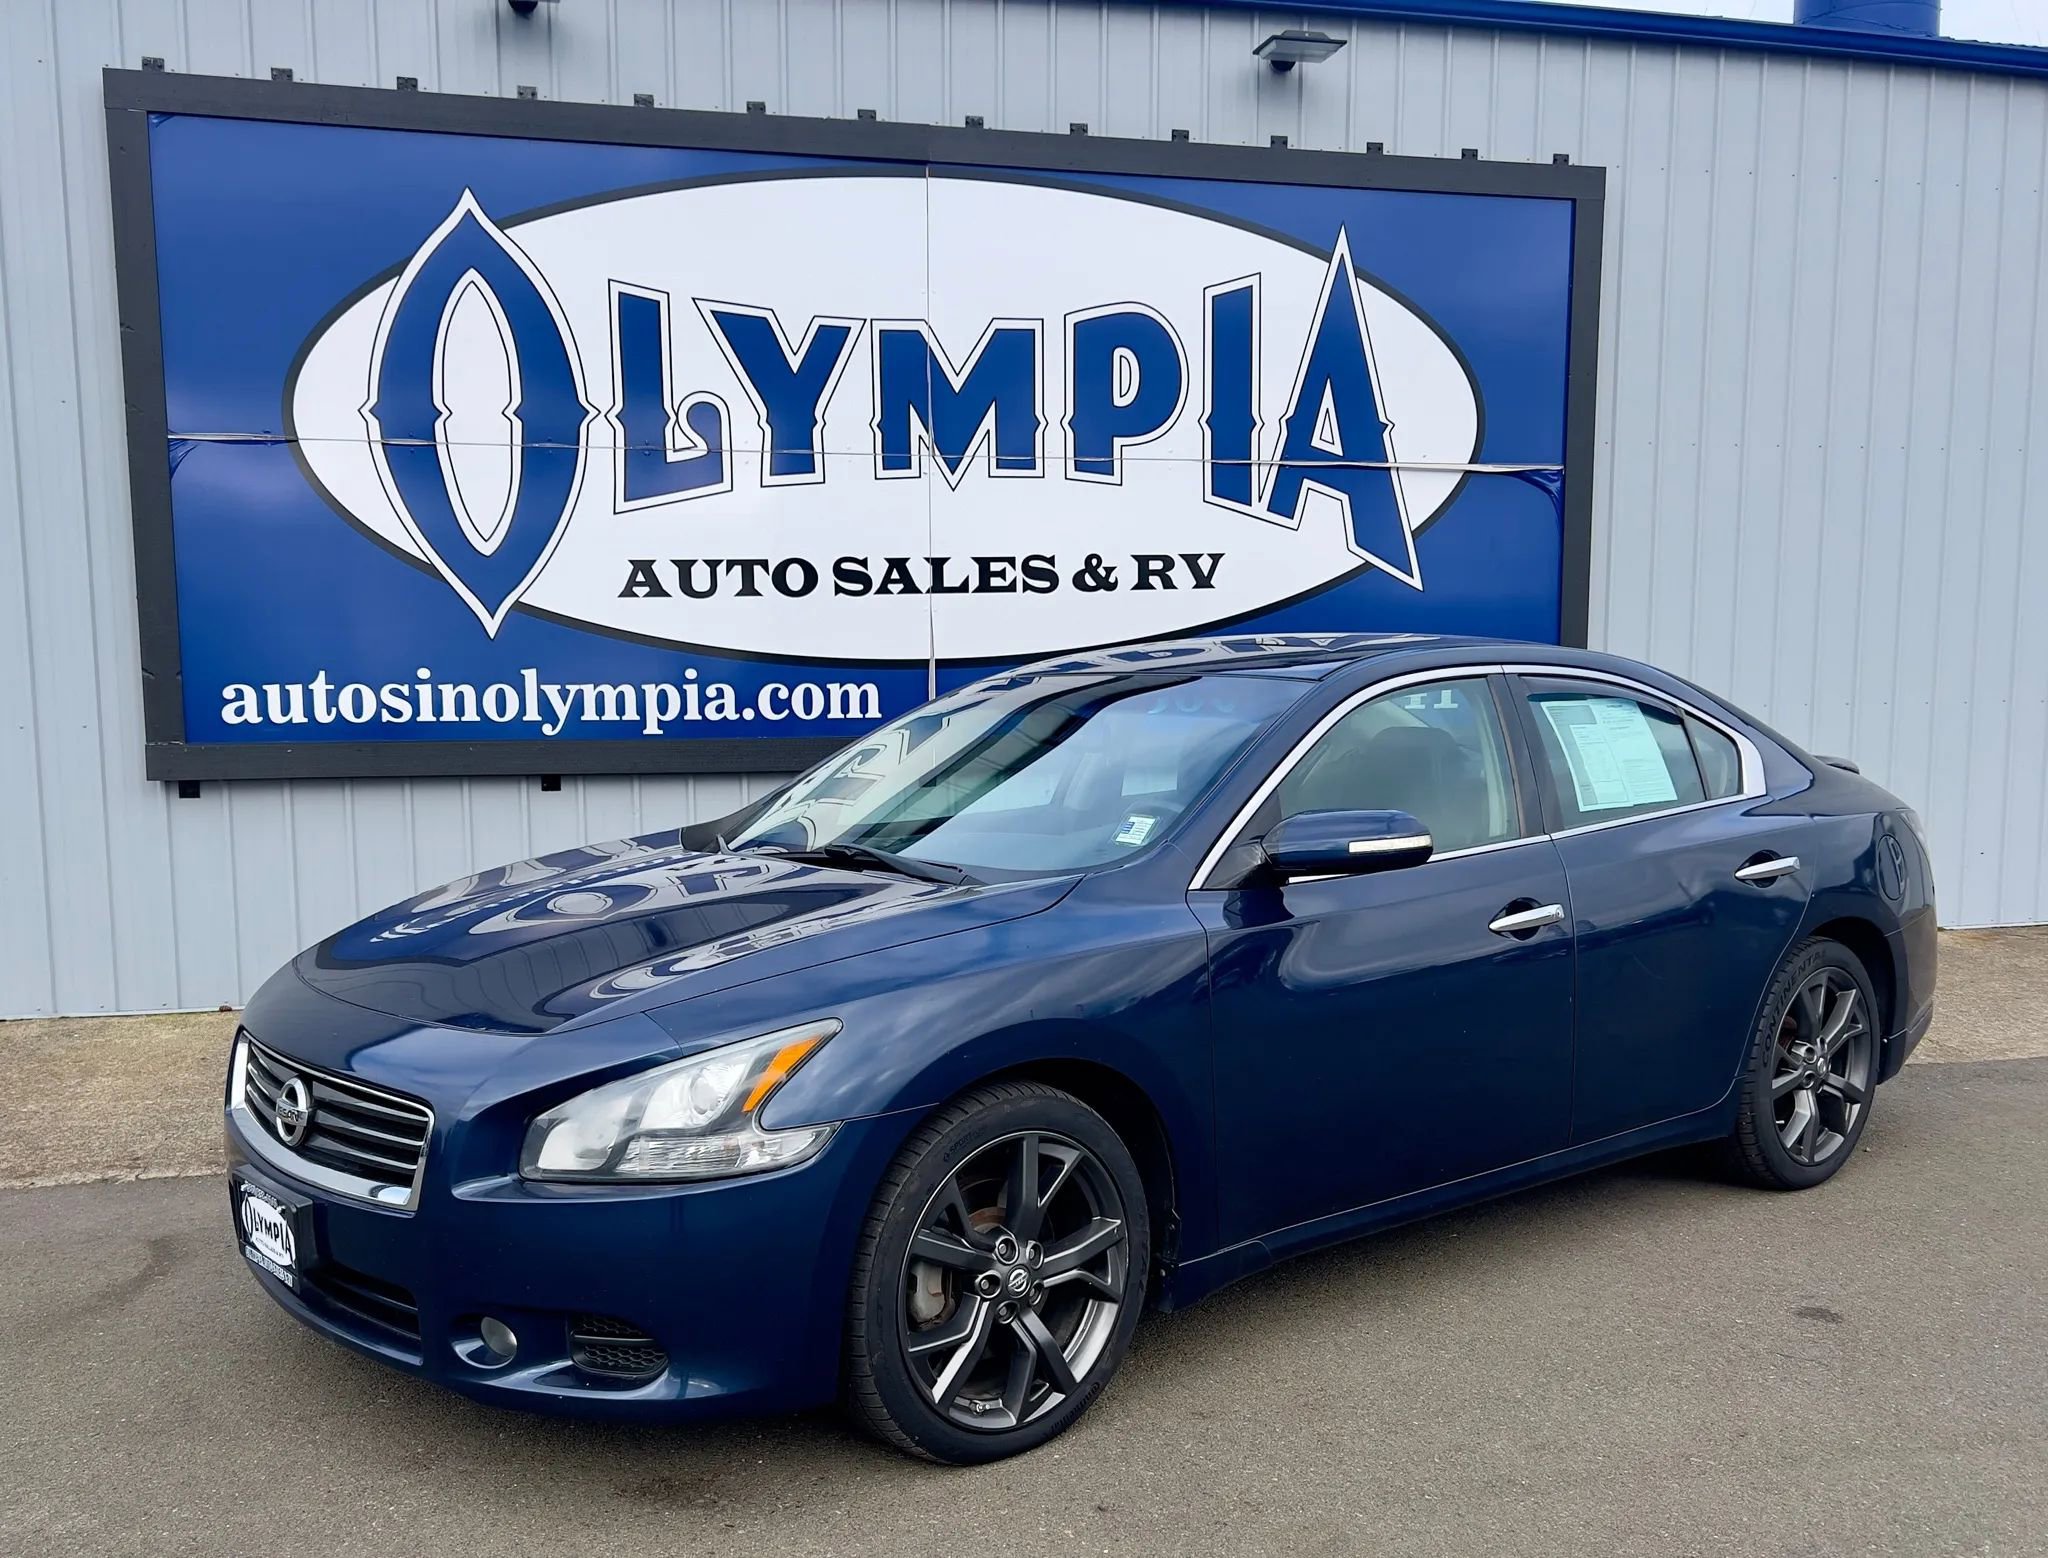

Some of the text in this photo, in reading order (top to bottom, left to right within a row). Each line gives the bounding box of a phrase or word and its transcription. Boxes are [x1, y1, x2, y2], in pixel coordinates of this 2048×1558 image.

[358, 187, 1424, 639] OLYMPIA
[617, 552, 1226, 598] AUTO SALES & RV
[221, 667, 882, 736] autosinolympia.com
[243, 1194, 295, 1268] OLYMPIA
